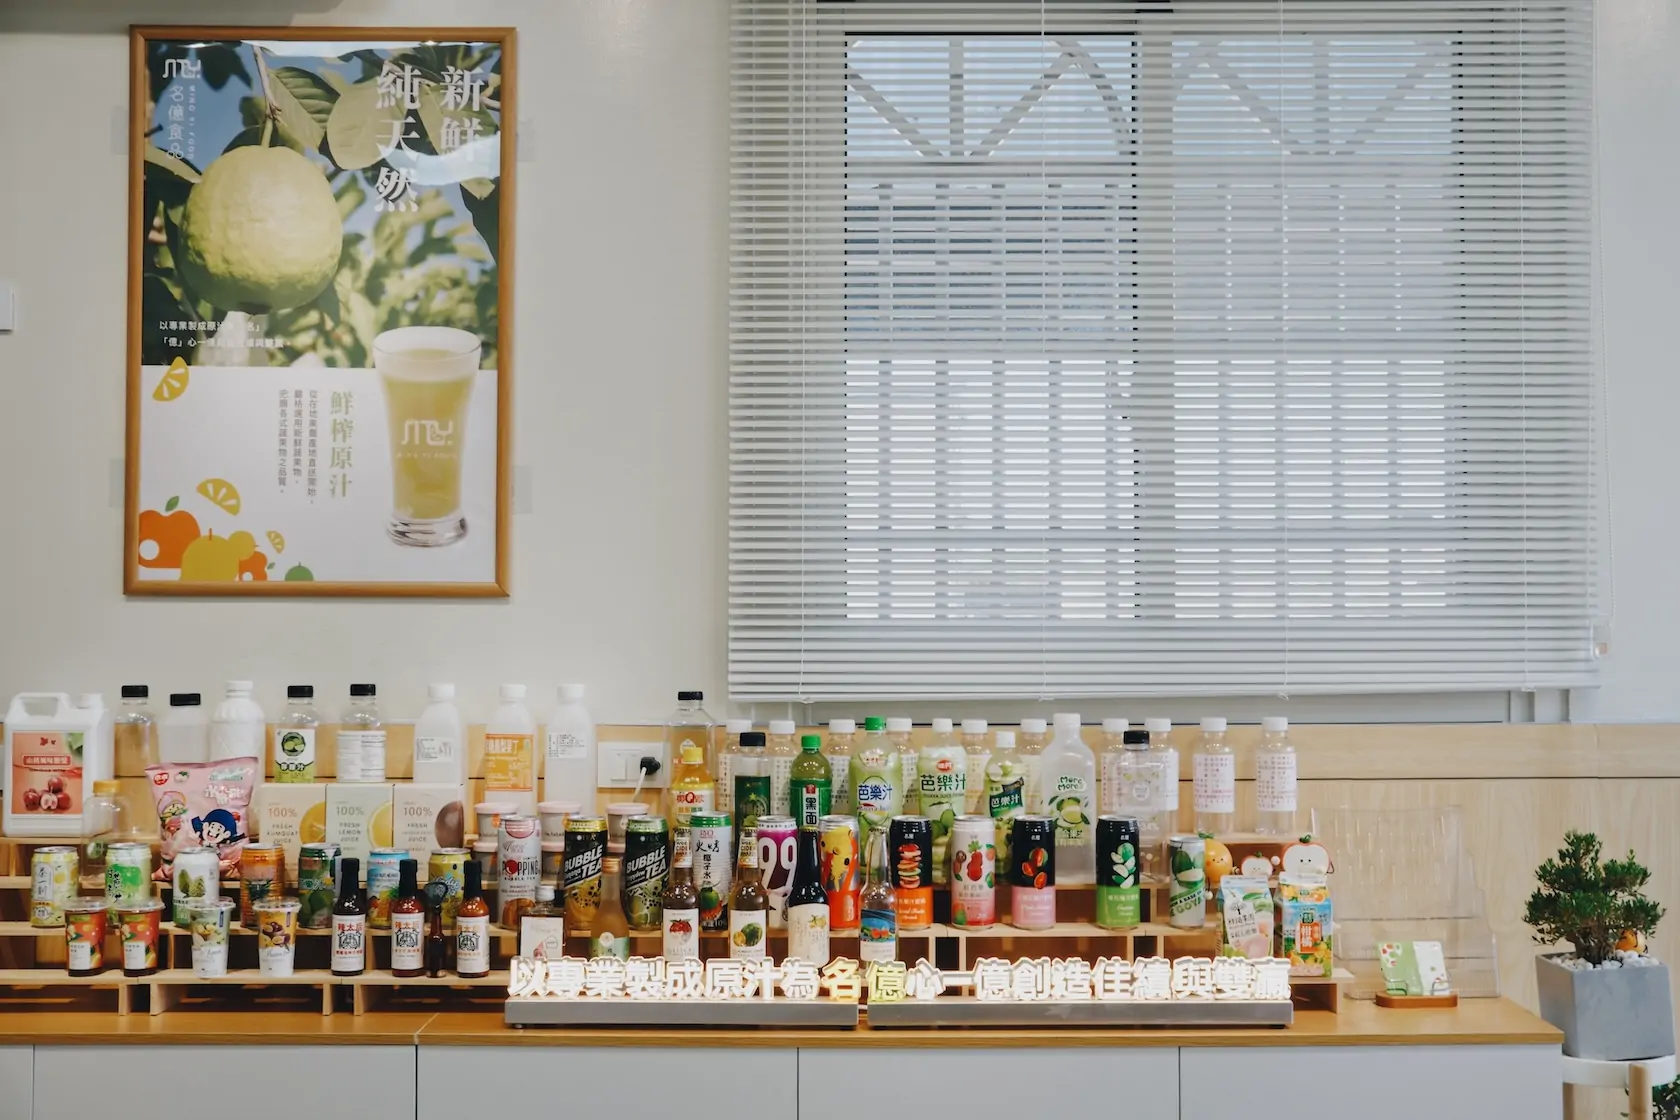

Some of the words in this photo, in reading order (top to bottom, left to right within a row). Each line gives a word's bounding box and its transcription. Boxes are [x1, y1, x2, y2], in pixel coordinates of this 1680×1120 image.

[439, 65, 487, 163] 新鮮
[374, 64, 421, 213] 純天然
[329, 389, 355, 499] 鮮榨原汁
[858, 784, 893, 801] 芭樂汁
[920, 773, 967, 792] 芭樂汁
[335, 806, 365, 816] 100%
[403, 806, 433, 817] 100%
[991, 793, 1020, 808] 芭樂汁
[268, 807, 298, 818] 100%
[565, 844, 603, 872] BUBBLE
[581, 857, 602, 879] TEA
[626, 844, 666, 874] BUBBLE
[646, 858, 667, 880] TEA
